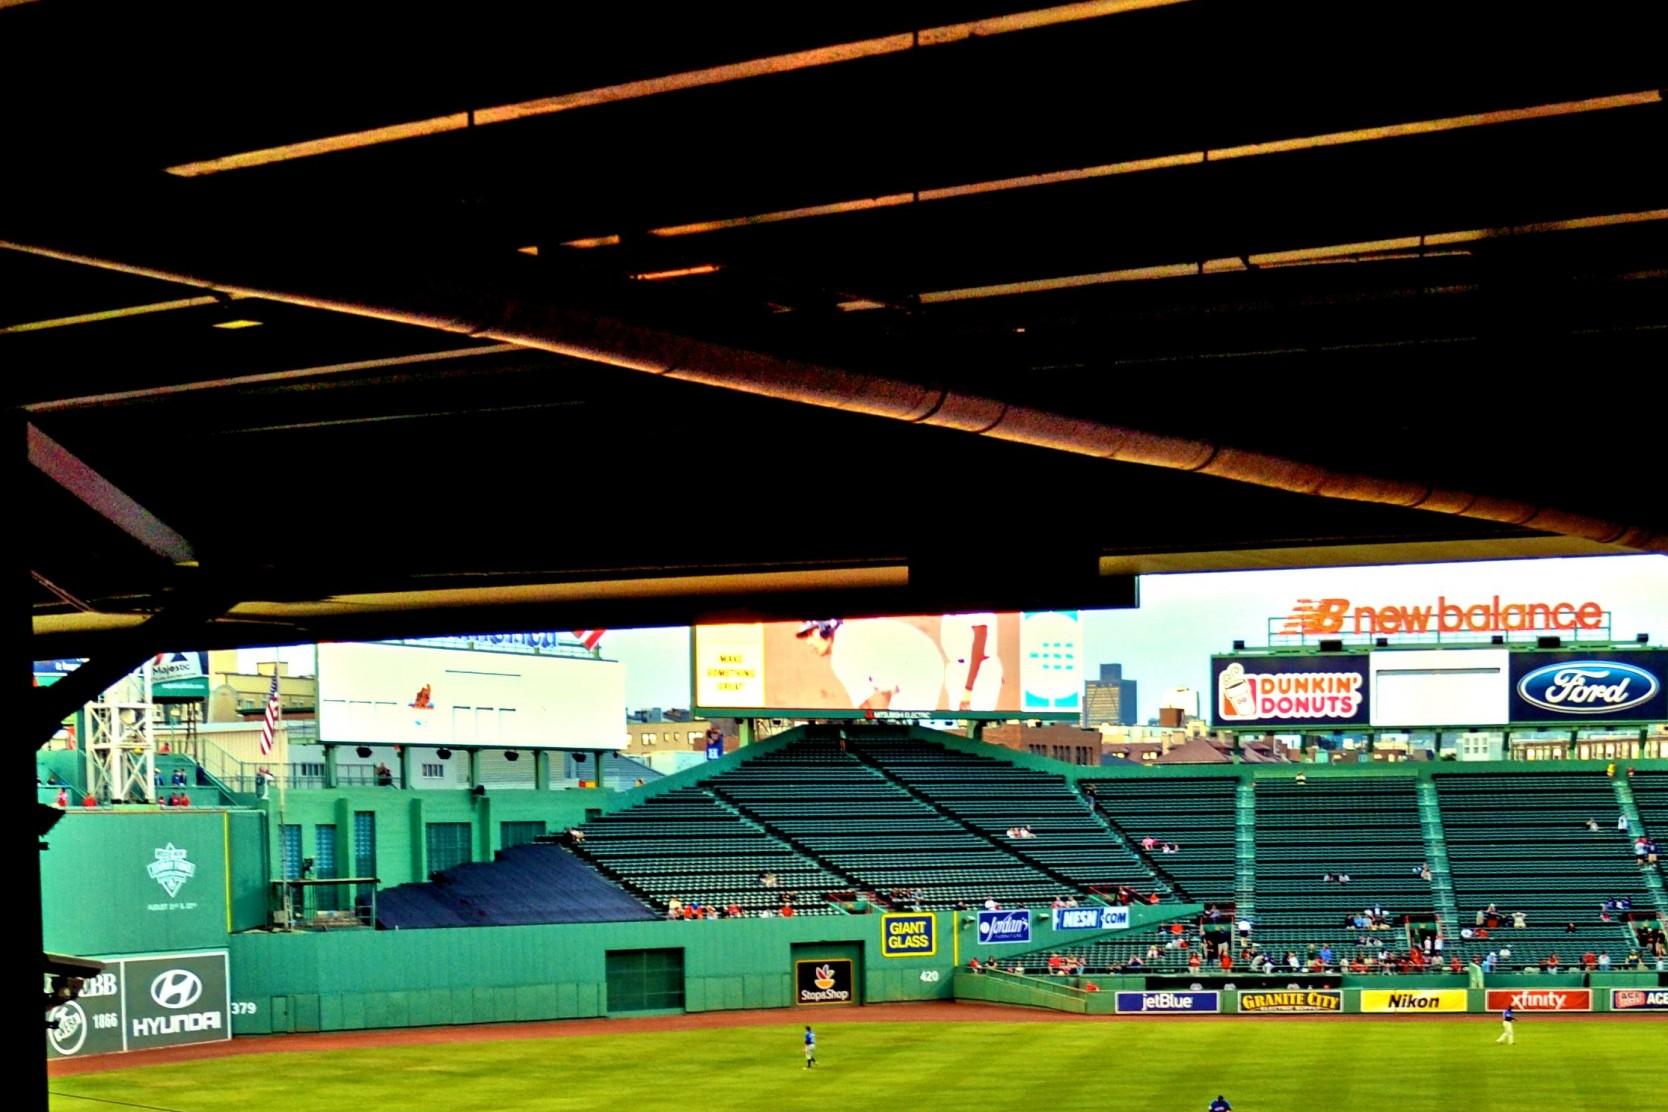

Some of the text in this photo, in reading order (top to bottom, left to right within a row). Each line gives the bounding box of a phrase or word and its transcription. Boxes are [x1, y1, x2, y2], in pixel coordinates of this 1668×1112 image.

[1354, 595, 1603, 634] new balance
[1260, 677, 1358, 695] DUNKIN'
[1545, 668, 1632, 703] Ford
[1261, 696, 1353, 714] DONUTS
[889, 921, 927, 935] GIANT
[1062, 910, 1098, 928] NESN
[888, 935, 929, 949] GLASS
[919, 970, 940, 982] 420
[231, 1003, 257, 1015] 379
[1141, 993, 1193, 1011] jetBlue
[1242, 991, 1340, 1010] GRANITE CITY
[1388, 994, 1440, 1009] Nikon
[1510, 992, 1567, 1010] xfinity
[133, 1011, 221, 1037] HYUNDAI
